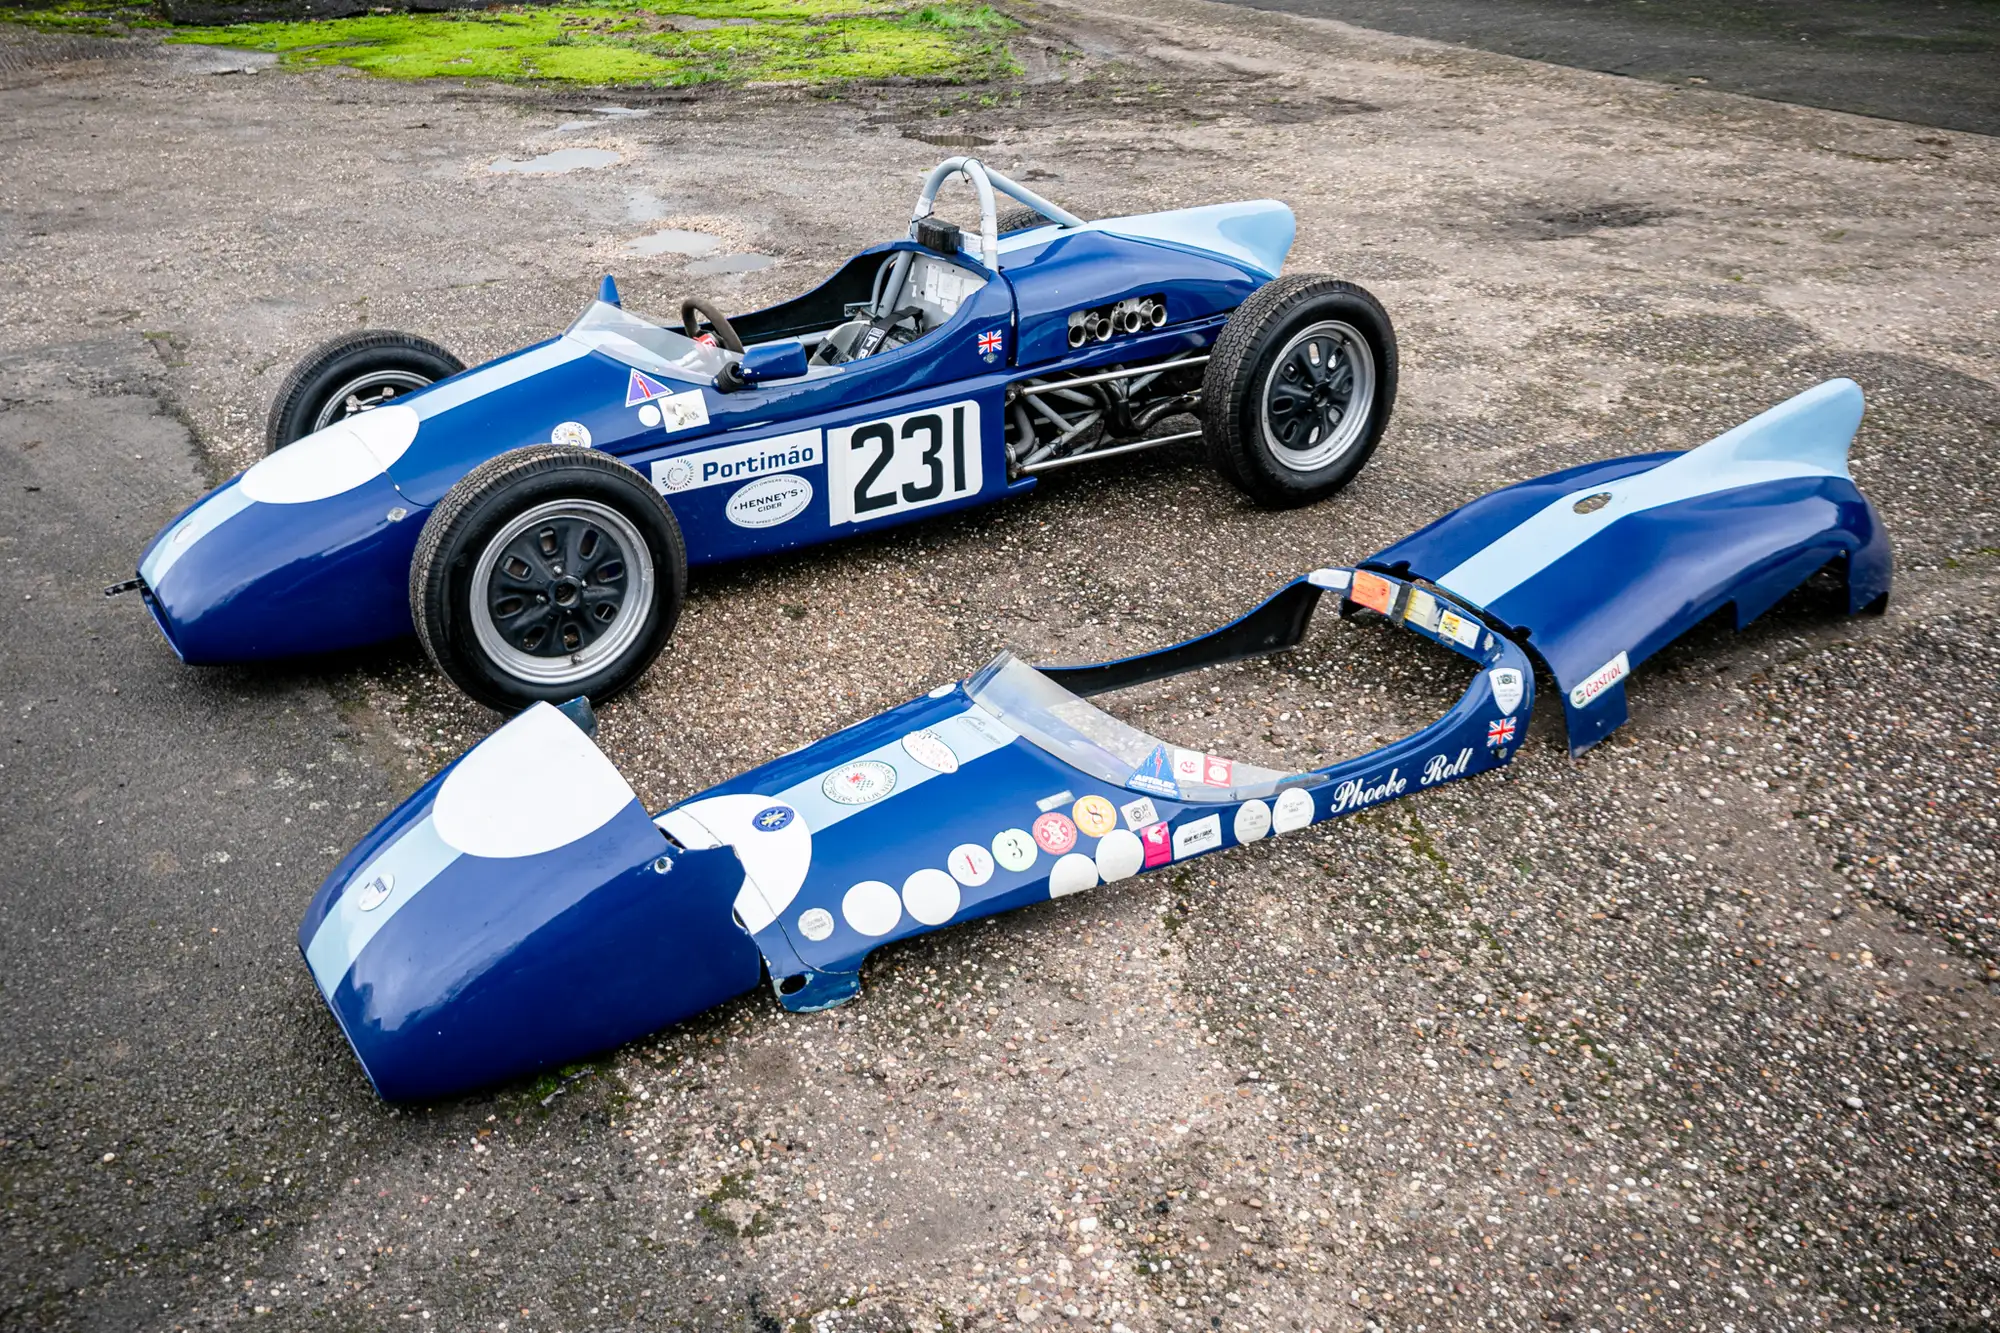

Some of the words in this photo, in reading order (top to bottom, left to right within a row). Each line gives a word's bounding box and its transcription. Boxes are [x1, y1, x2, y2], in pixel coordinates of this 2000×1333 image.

[702, 444, 814, 482] Portimão
[851, 406, 966, 515] 231
[737, 484, 759, 498] BUGATTI
[739, 488, 798, 510] HENNEY'S
[757, 502, 782, 513] CIDER
[1584, 663, 1621, 697] Castrol
[1330, 768, 1407, 813] Phoebe
[1420, 747, 1474, 785] Roll
